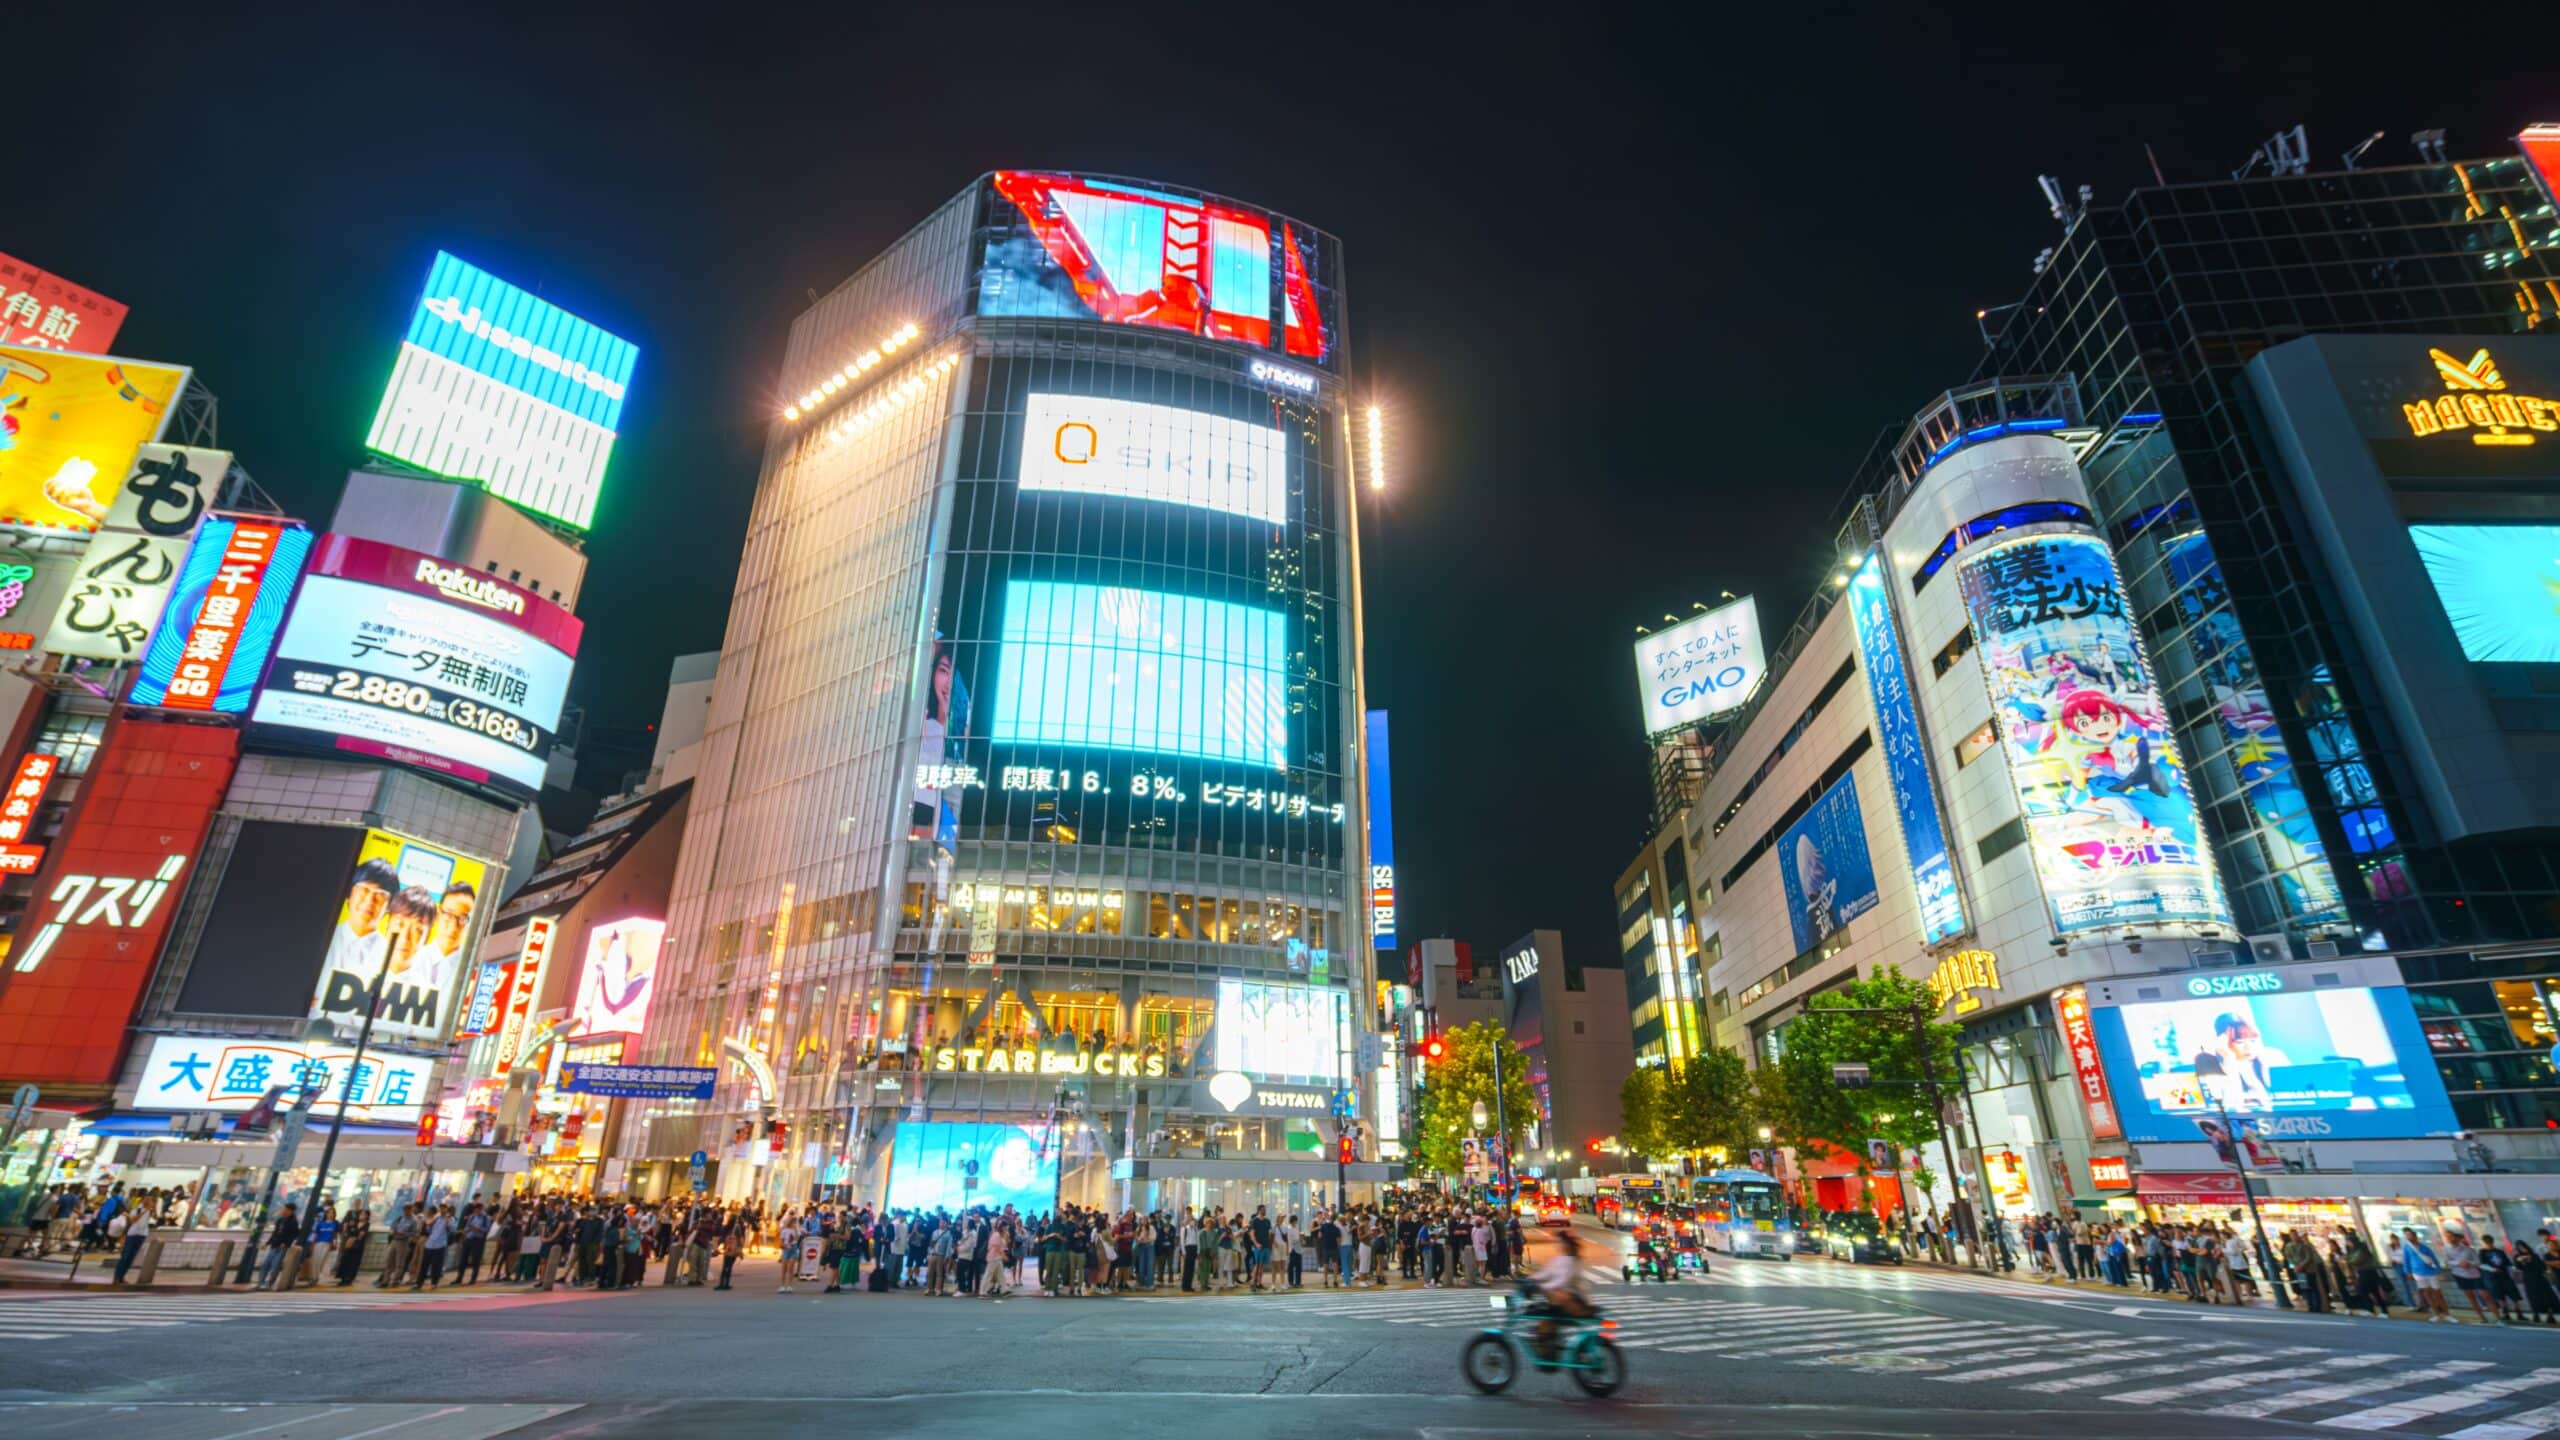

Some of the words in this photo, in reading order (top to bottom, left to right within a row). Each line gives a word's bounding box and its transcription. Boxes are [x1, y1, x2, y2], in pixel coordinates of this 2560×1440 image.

[0, 285, 80, 343] 角散
[66, 451, 205, 653] もんじゃ
[416, 559, 525, 615] Rakuten
[169, 530, 270, 697] 三千里薬品
[351, 634, 528, 707] データ無制限
[1654, 625, 1740, 666] すべての人に
[1657, 642, 1742, 682] インターネット
[1661, 666, 1746, 707] GMO
[14, 855, 186, 972] クスリ
[1055, 891, 1122, 908] LOUNGE
[1372, 865, 1395, 935] SEIBU
[1506, 947, 1539, 984] ZARA
[160, 1053, 416, 1105] 大盛堂書店
[936, 1047, 1165, 1077] STARBUCKS
[1257, 1090, 1326, 1109] TSUTAYA
